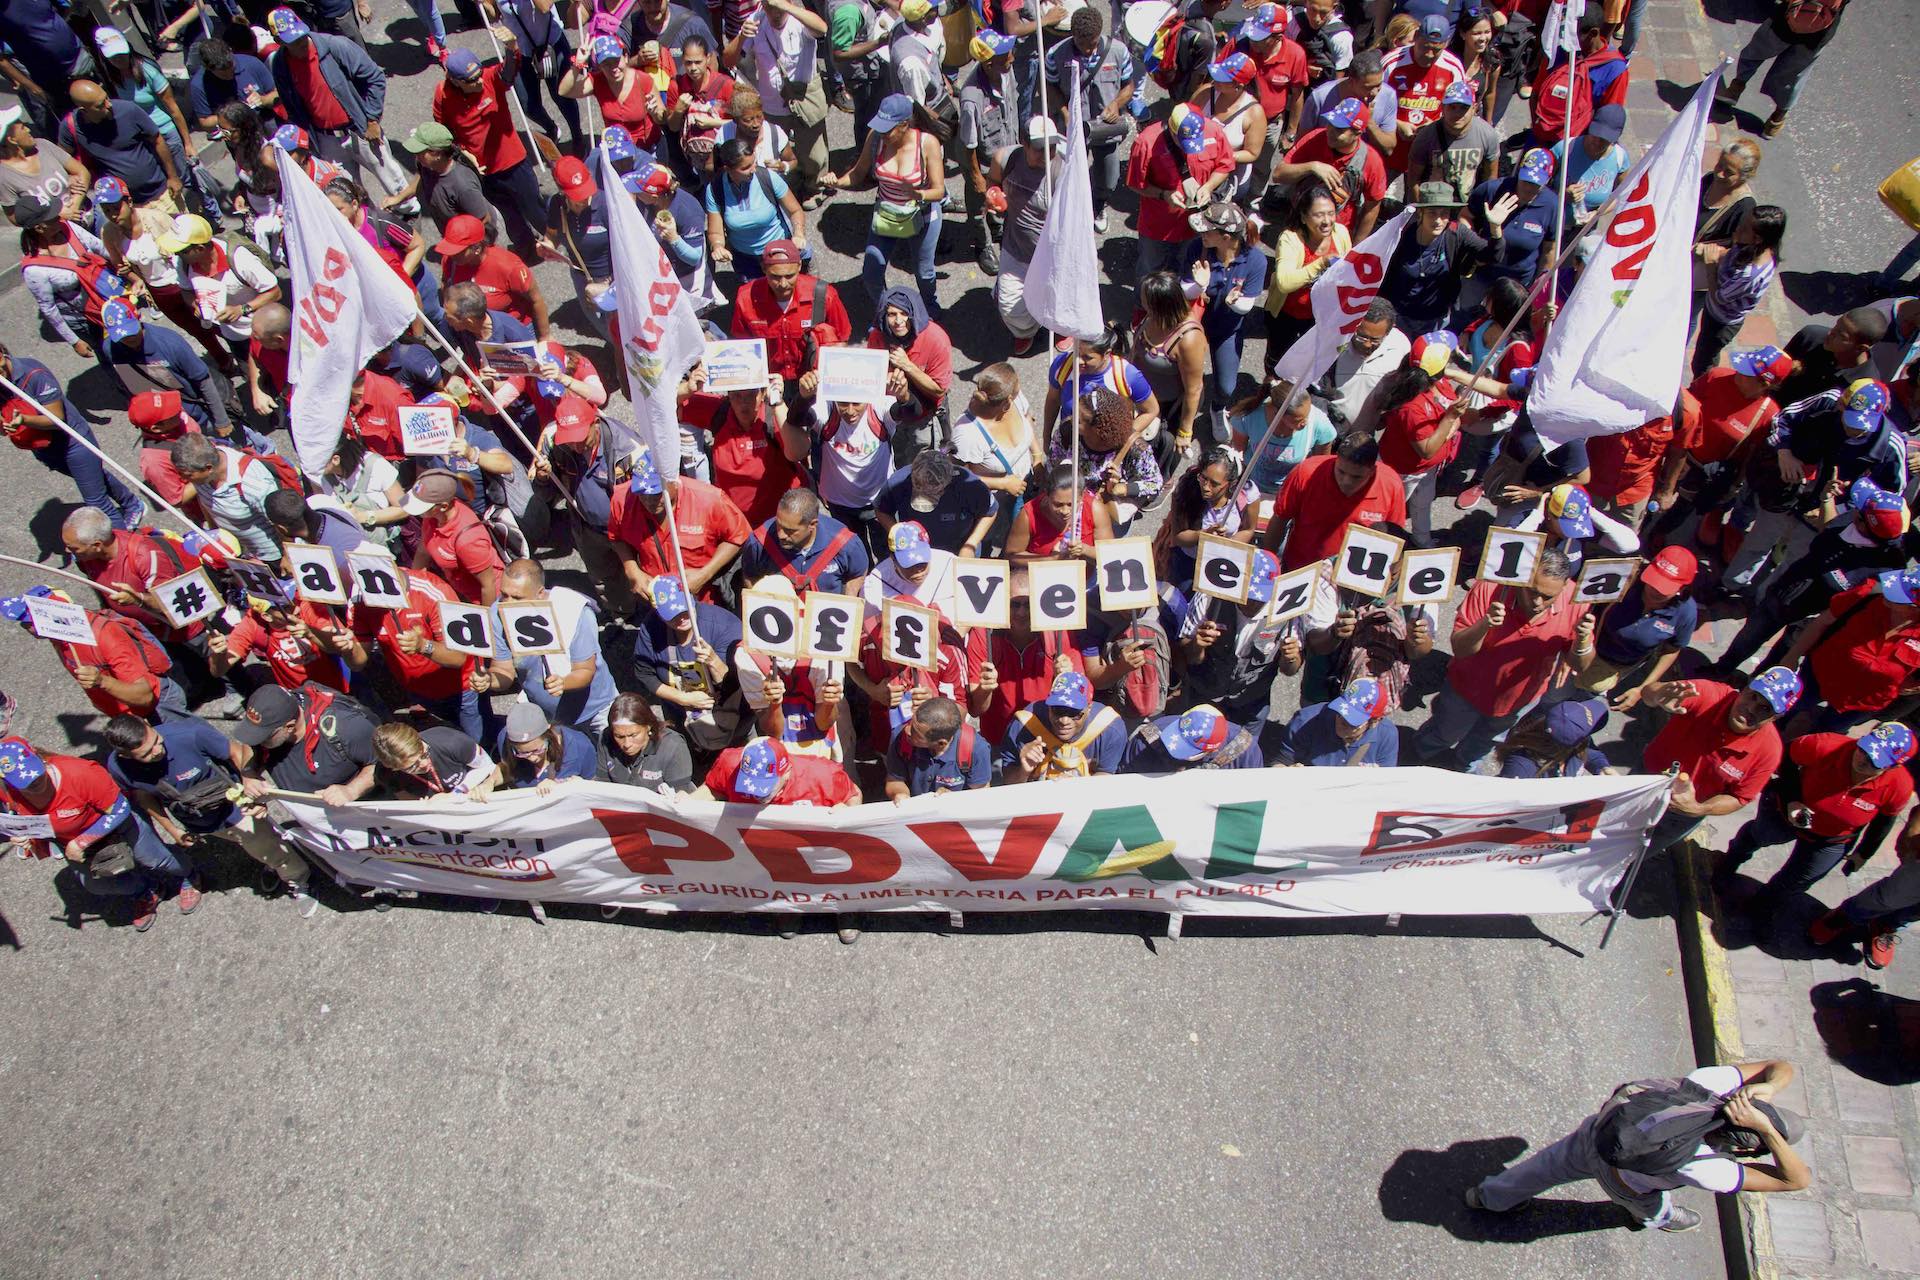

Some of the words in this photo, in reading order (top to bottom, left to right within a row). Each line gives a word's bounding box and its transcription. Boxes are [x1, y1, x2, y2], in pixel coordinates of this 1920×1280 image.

[591, 800, 1307, 884] PDVAL
[640, 883, 813, 903] SEGURIDAD
[822, 888, 1027, 902] ALIMENTARIA
[1036, 887, 1118, 902] PARA
[1128, 888, 1165, 900] EL
[1175, 880, 1297, 899] PUEBLO
